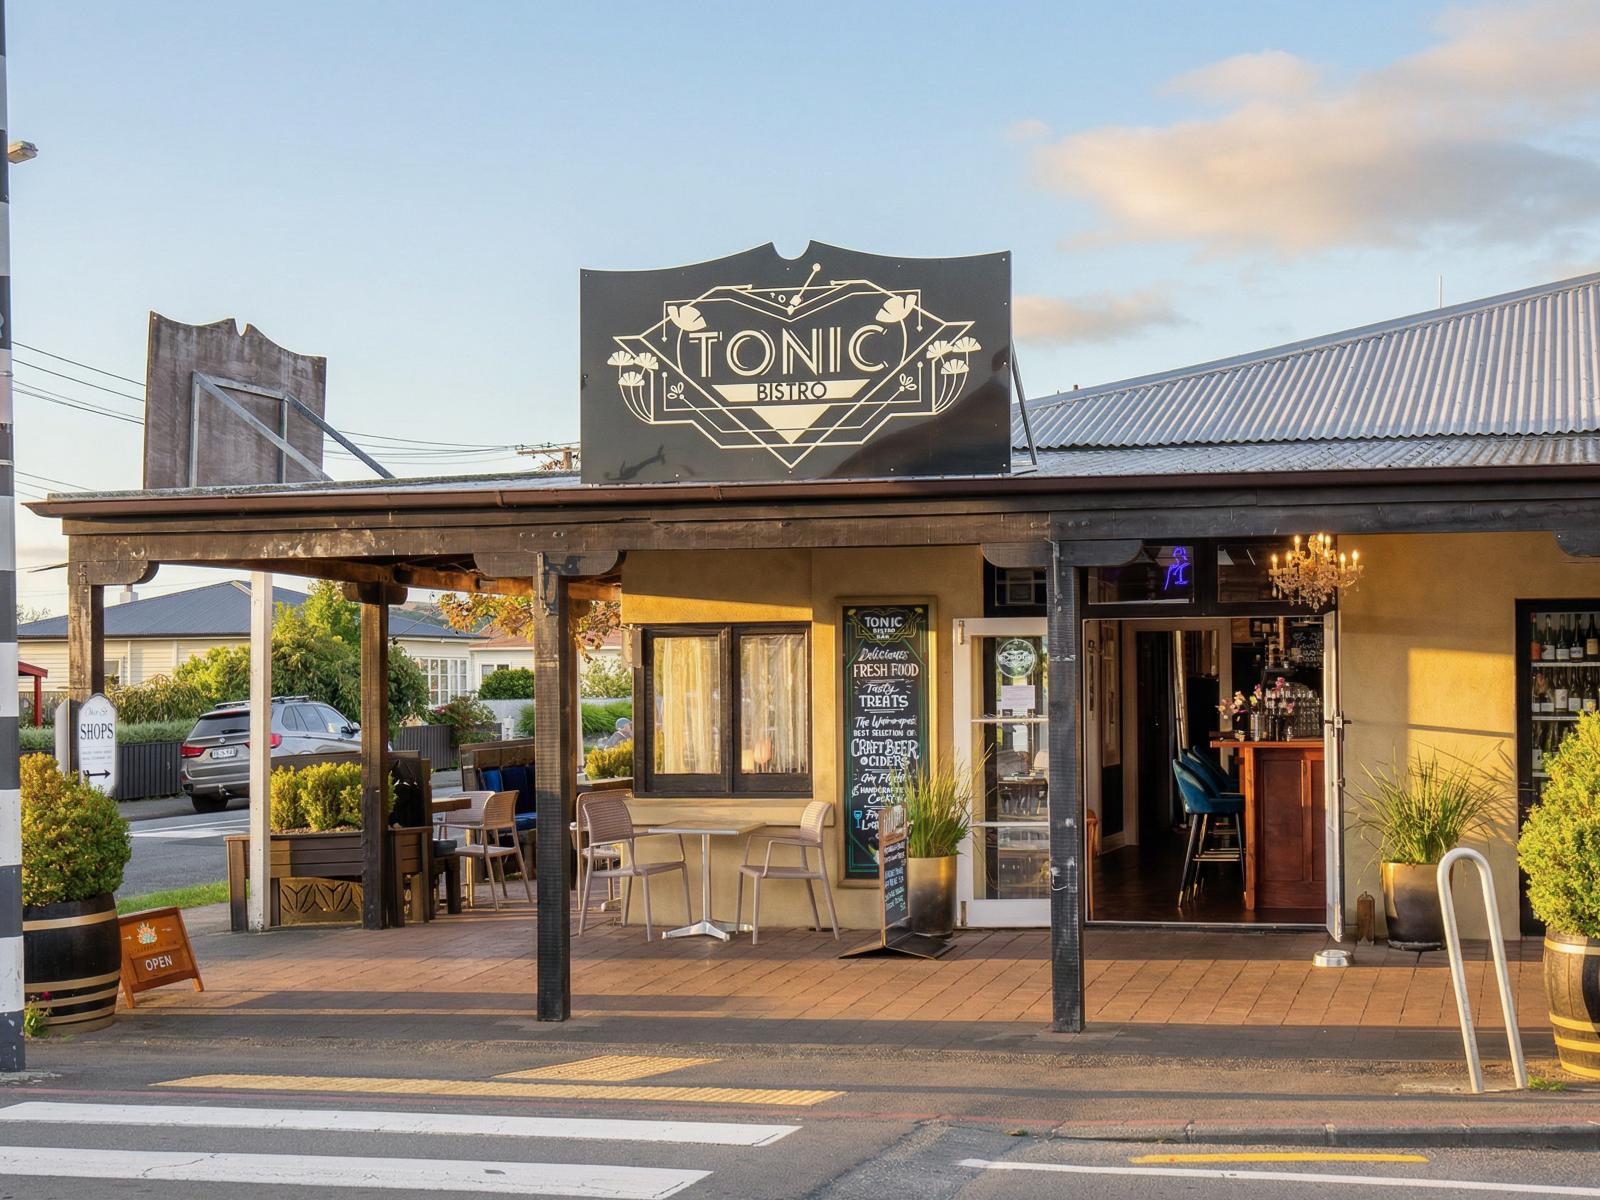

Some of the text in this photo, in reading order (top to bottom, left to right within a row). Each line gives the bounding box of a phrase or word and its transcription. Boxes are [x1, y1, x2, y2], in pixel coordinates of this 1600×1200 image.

[689, 324, 889, 378] TONIC
[757, 382, 827, 400] BISTRO
[864, 616, 903, 627] TONIC
[853, 663, 919, 677] FRESH FOOD
[863, 683, 900, 695] Tasty
[859, 695, 909, 707] TREATS
[854, 716, 870, 728] The
[80, 722, 113, 740] SHOPS
[853, 729, 869, 737] BEST
[851, 738, 919, 759] CRAFT BEER
[145, 955, 173, 971] OPEN
